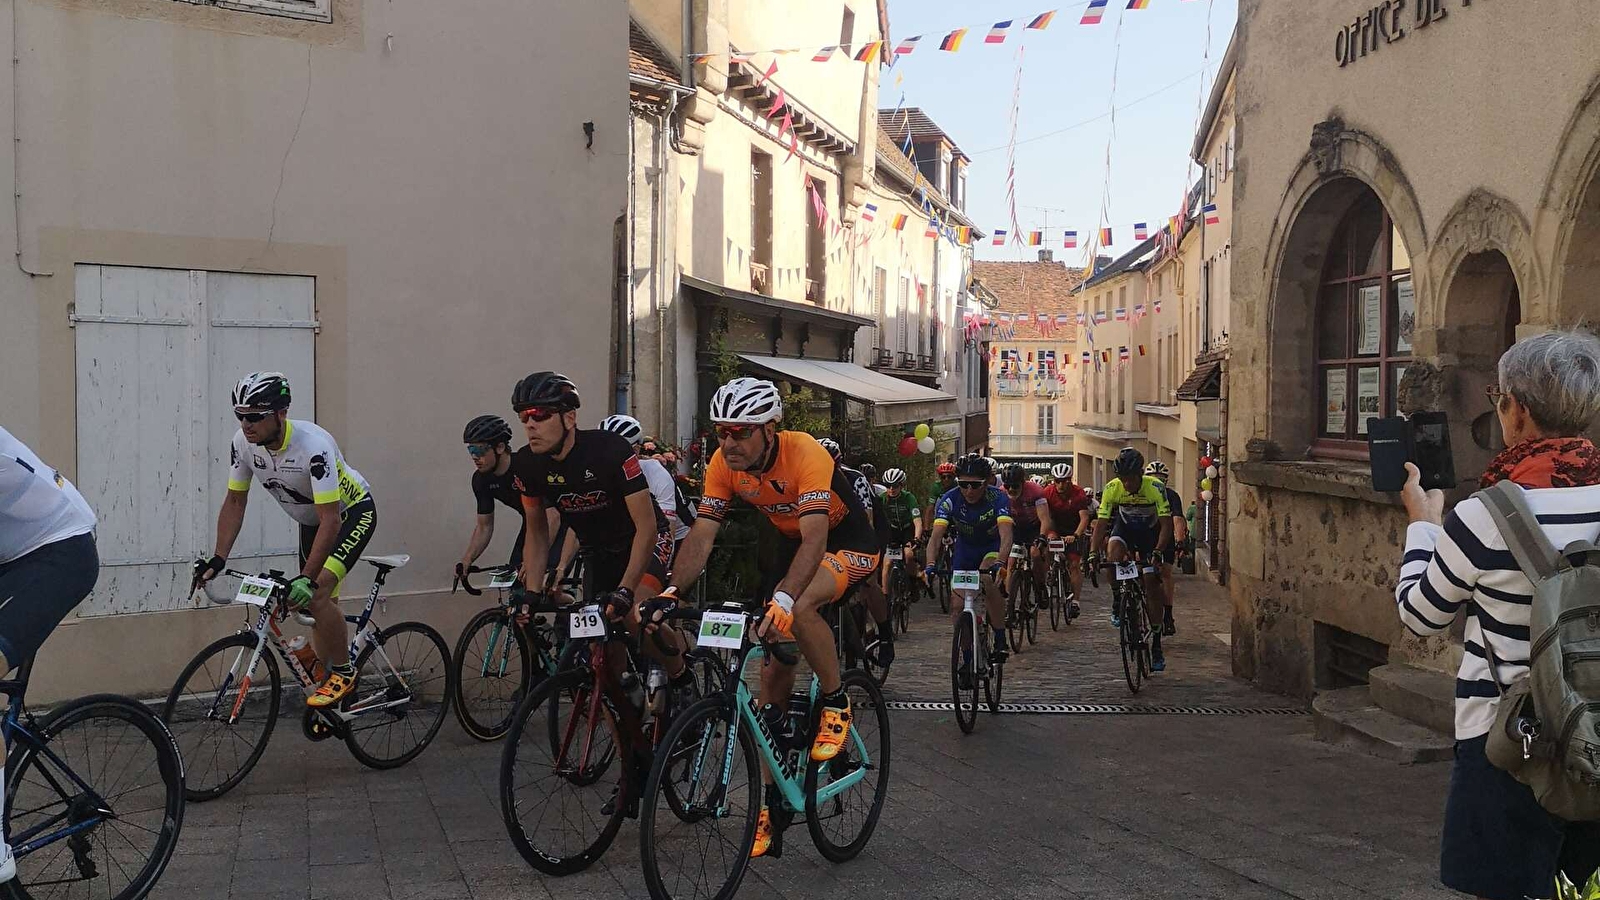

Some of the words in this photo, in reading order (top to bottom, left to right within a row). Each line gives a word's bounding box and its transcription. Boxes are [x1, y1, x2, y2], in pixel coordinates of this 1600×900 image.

[1335, 0, 1405, 67] OFFICE
[333, 510, 374, 561] L'ALPANA
[960, 575, 972, 583] 36
[244, 584, 267, 597] 127
[574, 614, 598, 628] 319
[711, 622, 732, 637] 87
[747, 697, 796, 781] Bianchi
